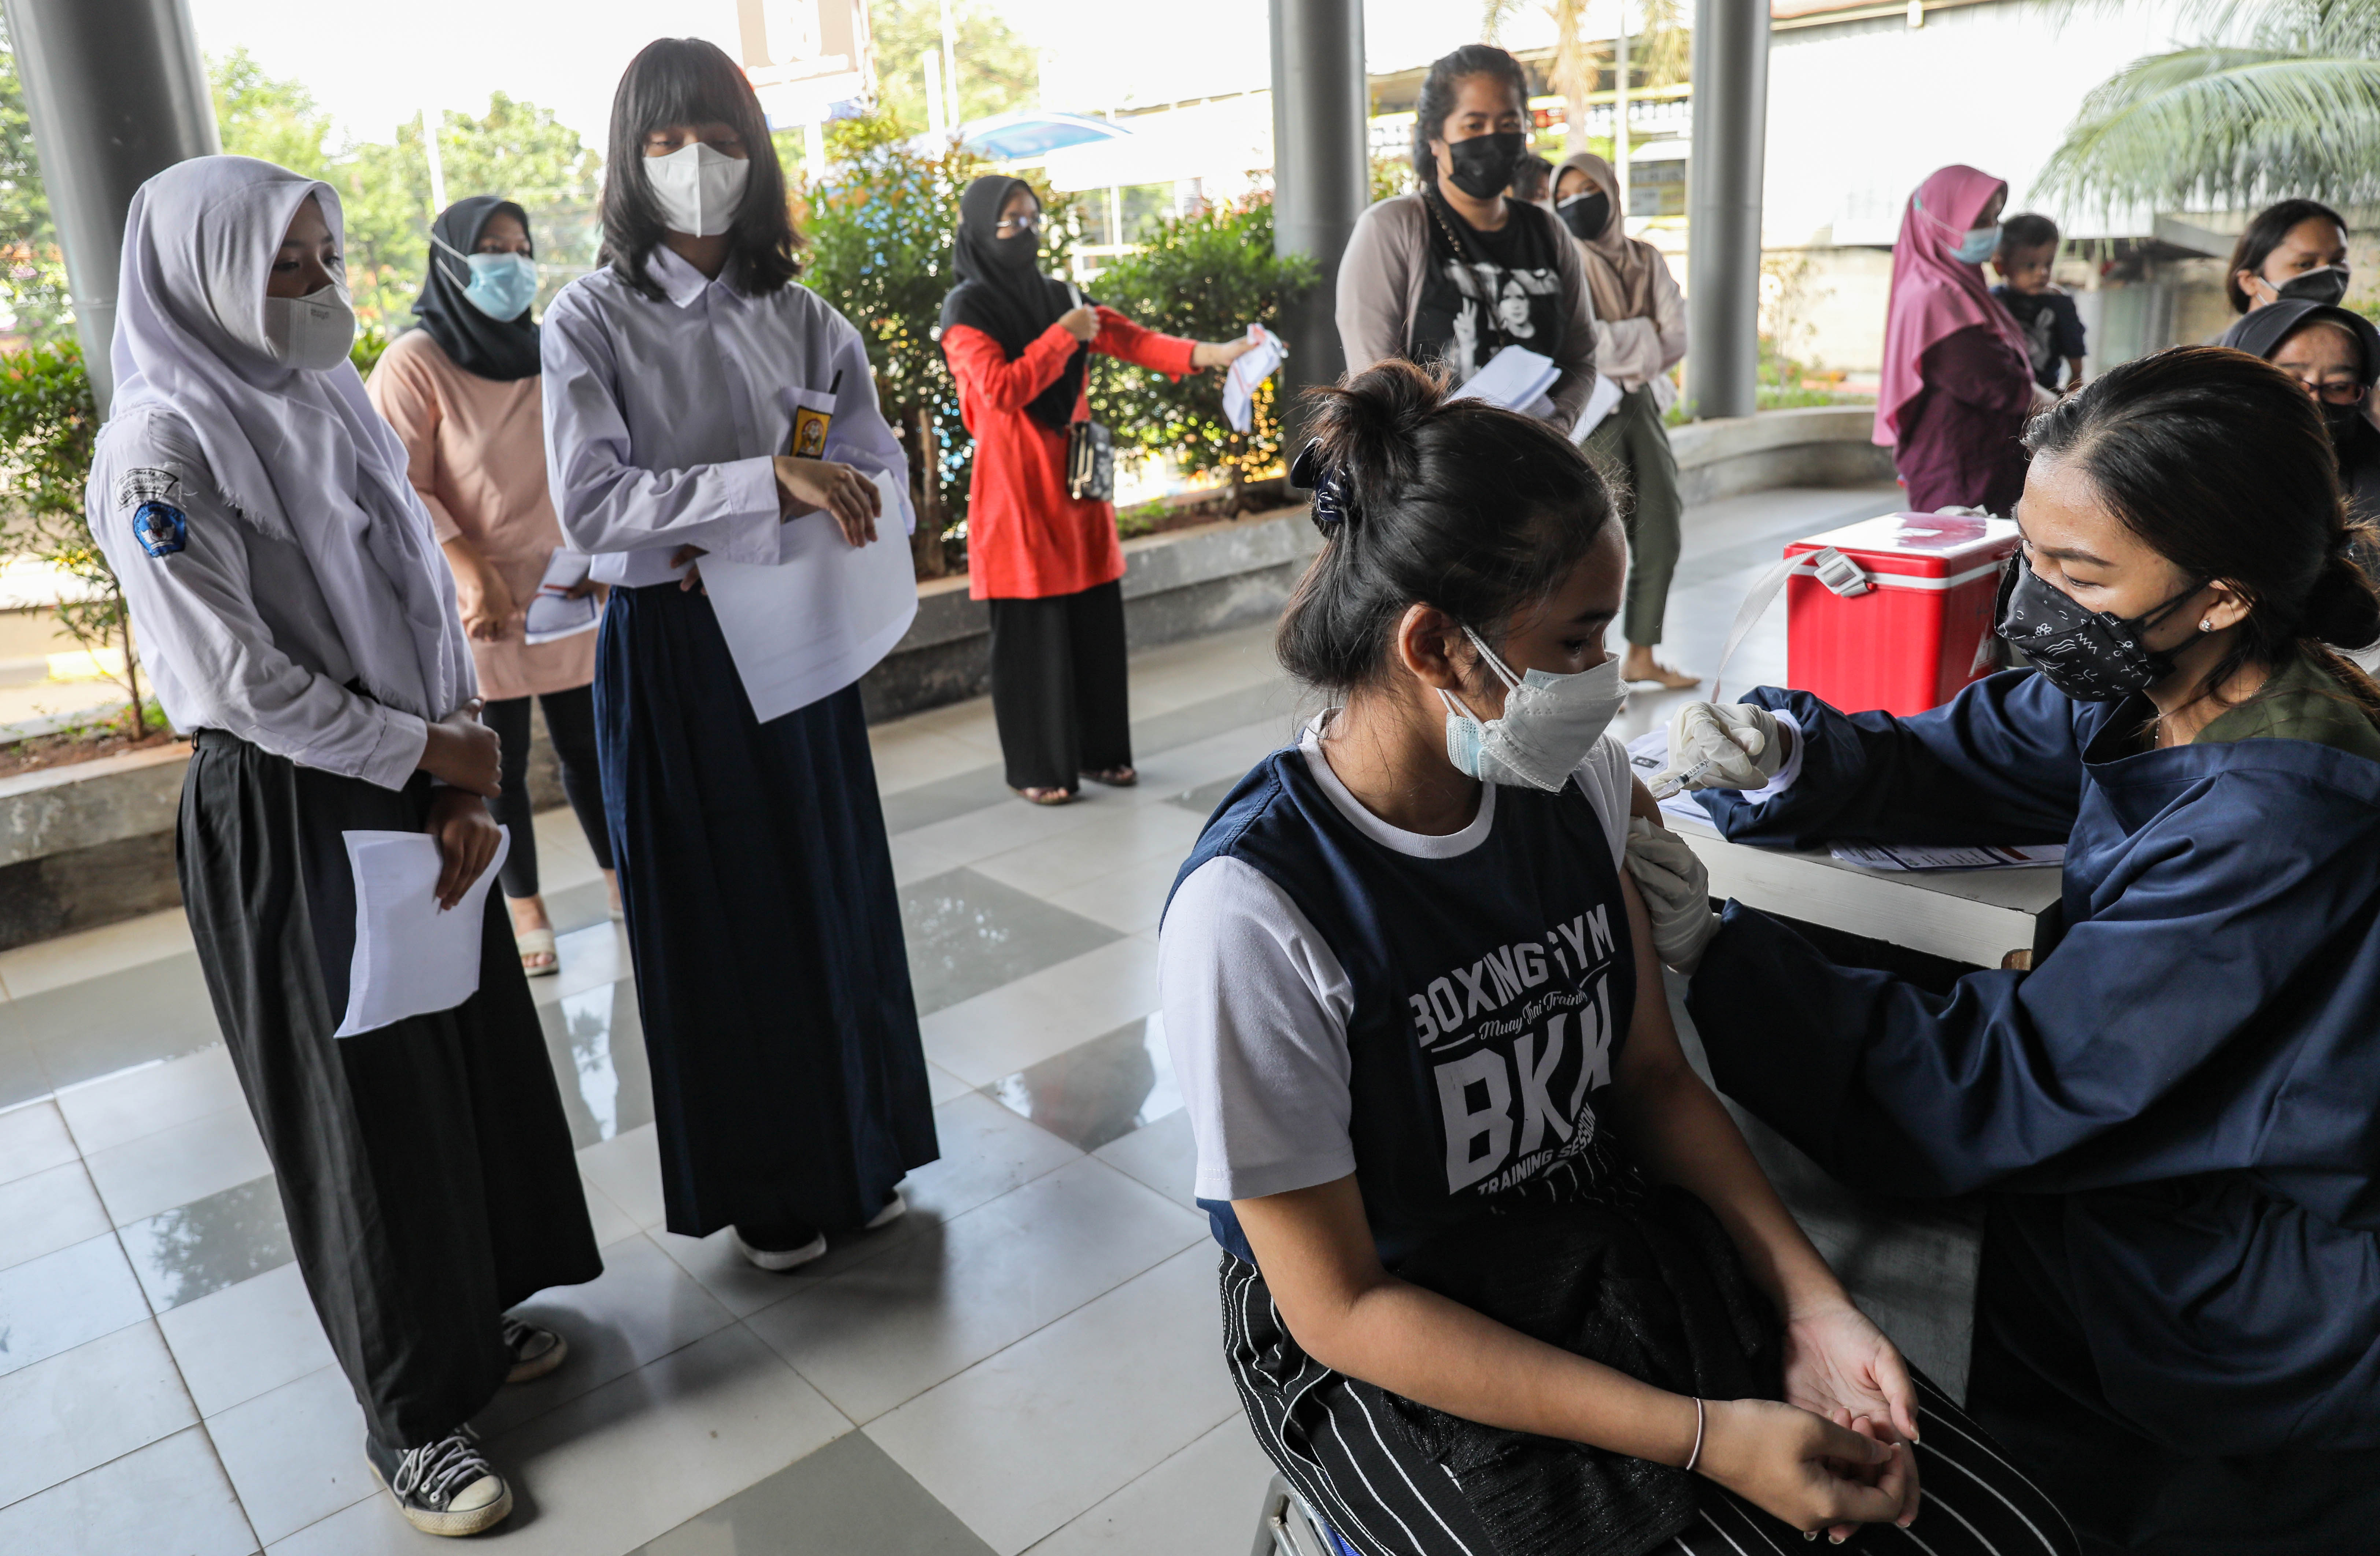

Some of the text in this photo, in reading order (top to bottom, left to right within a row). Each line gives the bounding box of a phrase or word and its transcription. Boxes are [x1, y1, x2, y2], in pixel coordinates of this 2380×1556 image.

[1479, 1017, 1523, 1040] Muay
[1522, 999, 1542, 1025] Thai
[1434, 972, 1612, 1195] BKK
[1478, 1101, 1596, 1196] TRAINING SESSION
